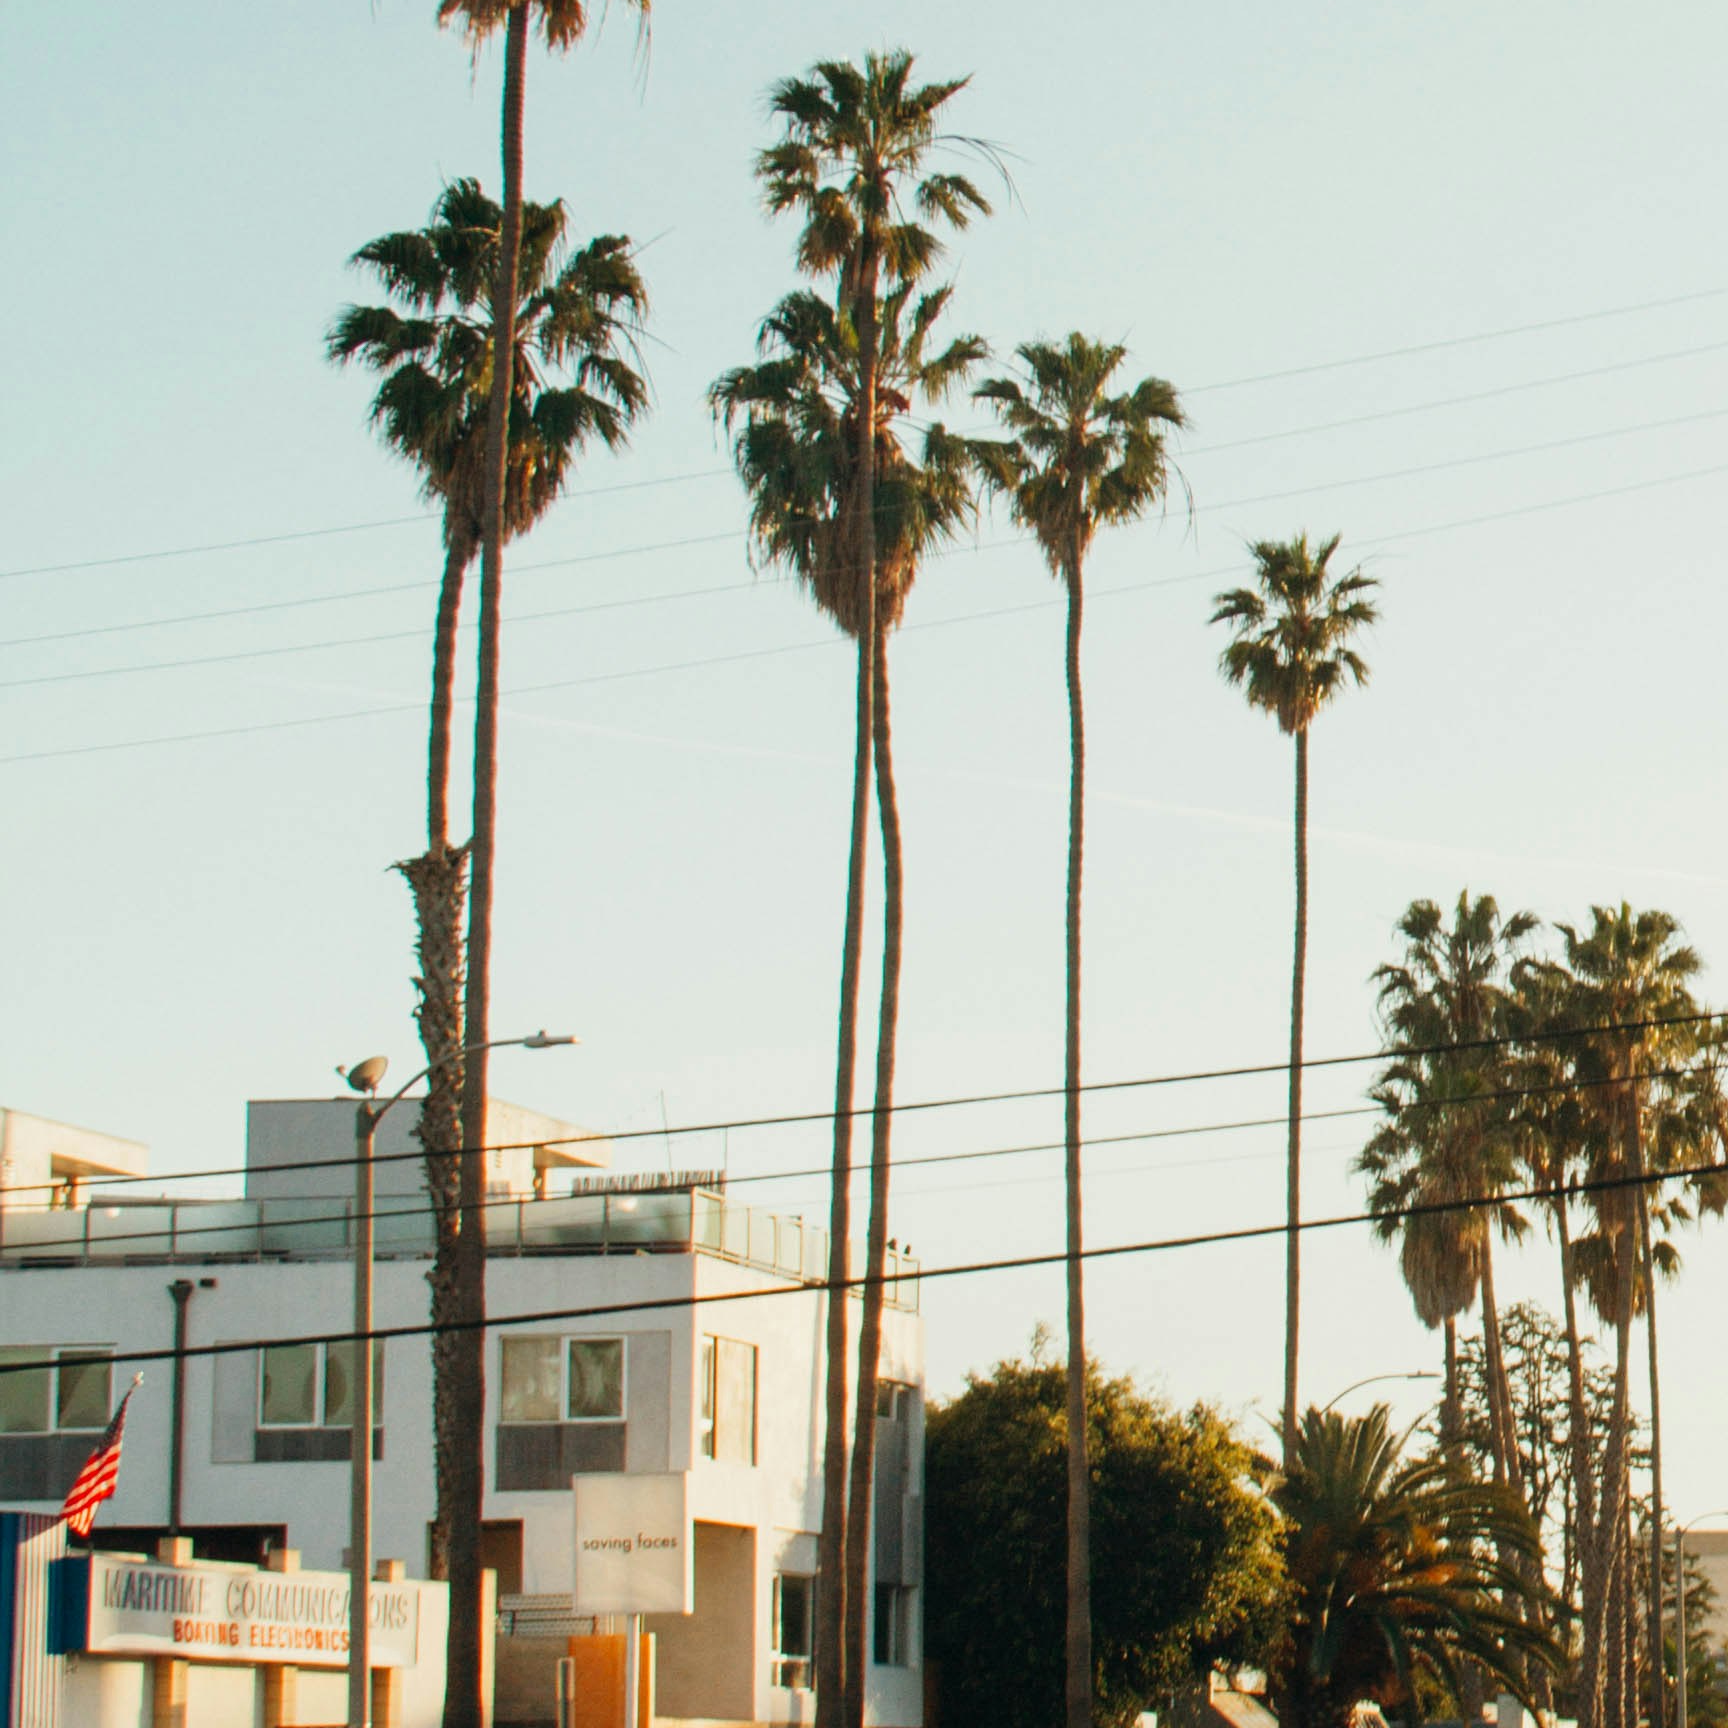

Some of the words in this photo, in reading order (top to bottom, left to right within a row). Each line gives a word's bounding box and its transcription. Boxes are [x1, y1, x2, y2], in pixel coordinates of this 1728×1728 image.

[583, 1536, 632, 1553] saving
[637, 1532, 678, 1548] faces
[226, 1579, 408, 1629] COMMUNICONS
[173, 1618, 240, 1646] BOATING
[250, 1626, 350, 1652] ELECTRONICS
